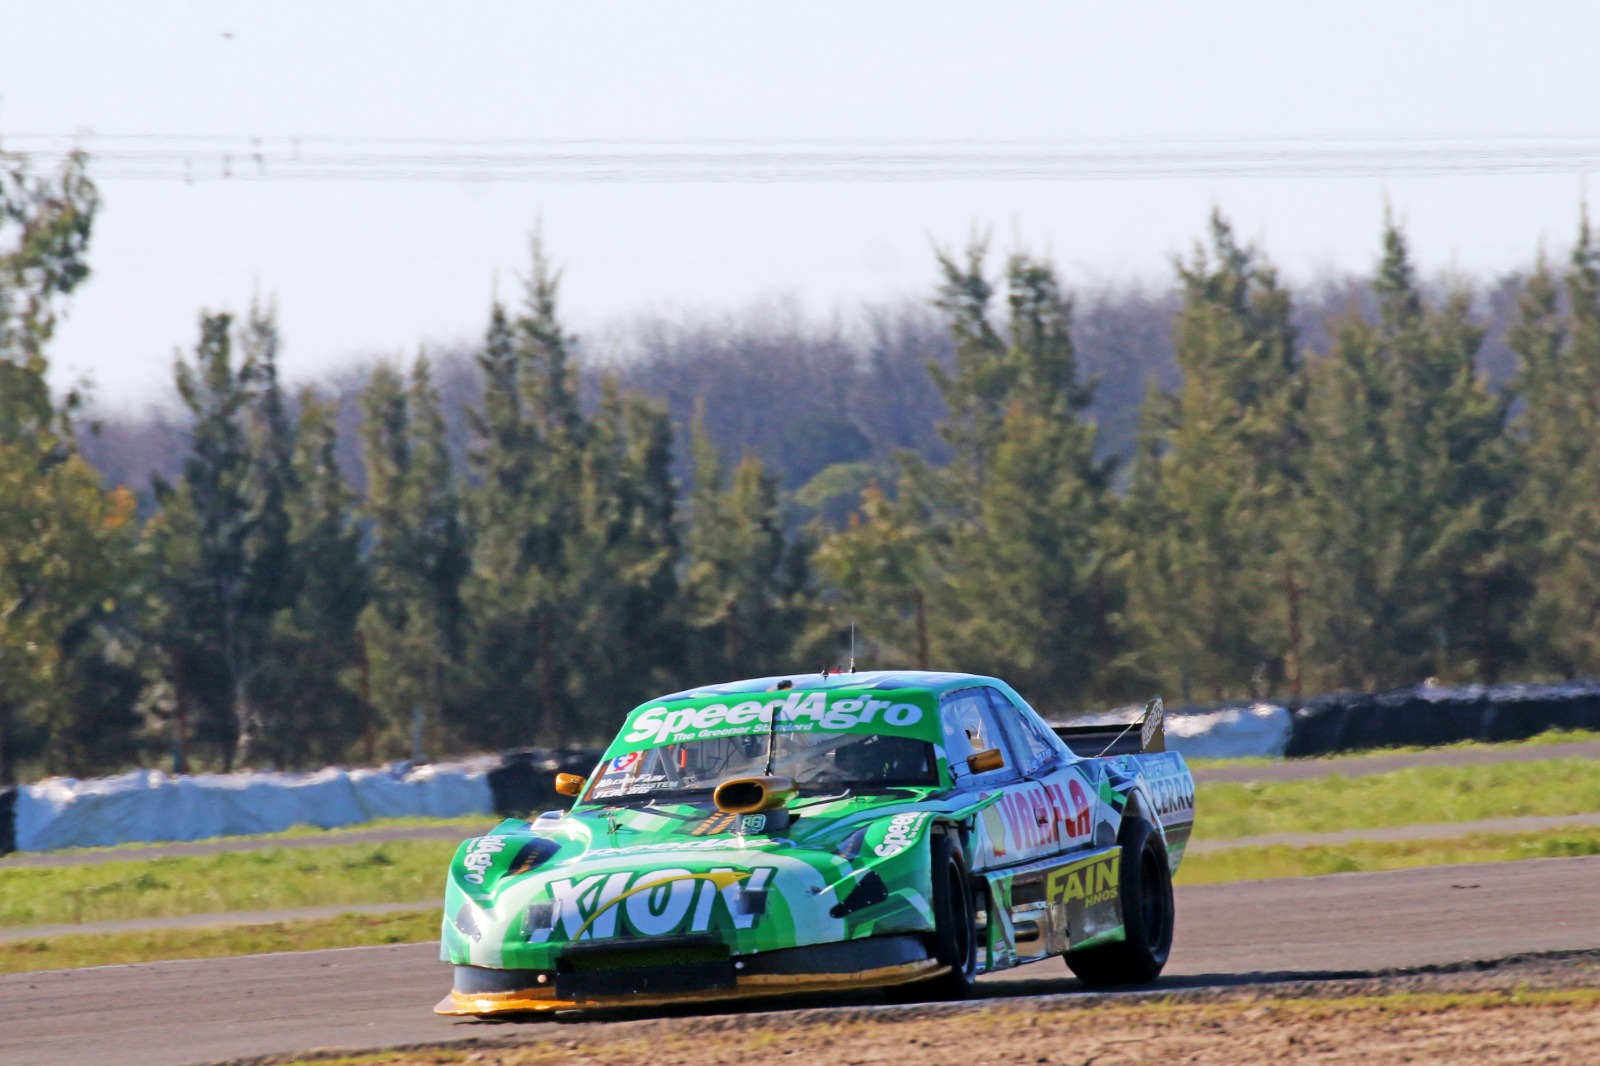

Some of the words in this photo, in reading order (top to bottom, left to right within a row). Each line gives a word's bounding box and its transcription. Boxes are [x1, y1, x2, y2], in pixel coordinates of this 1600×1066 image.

[625, 692, 923, 744] SpeedAgro
[673, 732, 695, 742] The
[698, 727, 752, 738] Greener
[1046, 847, 1121, 905] FAIN
[1085, 888, 1119, 909] HNOS
[527, 866, 780, 944] XION
